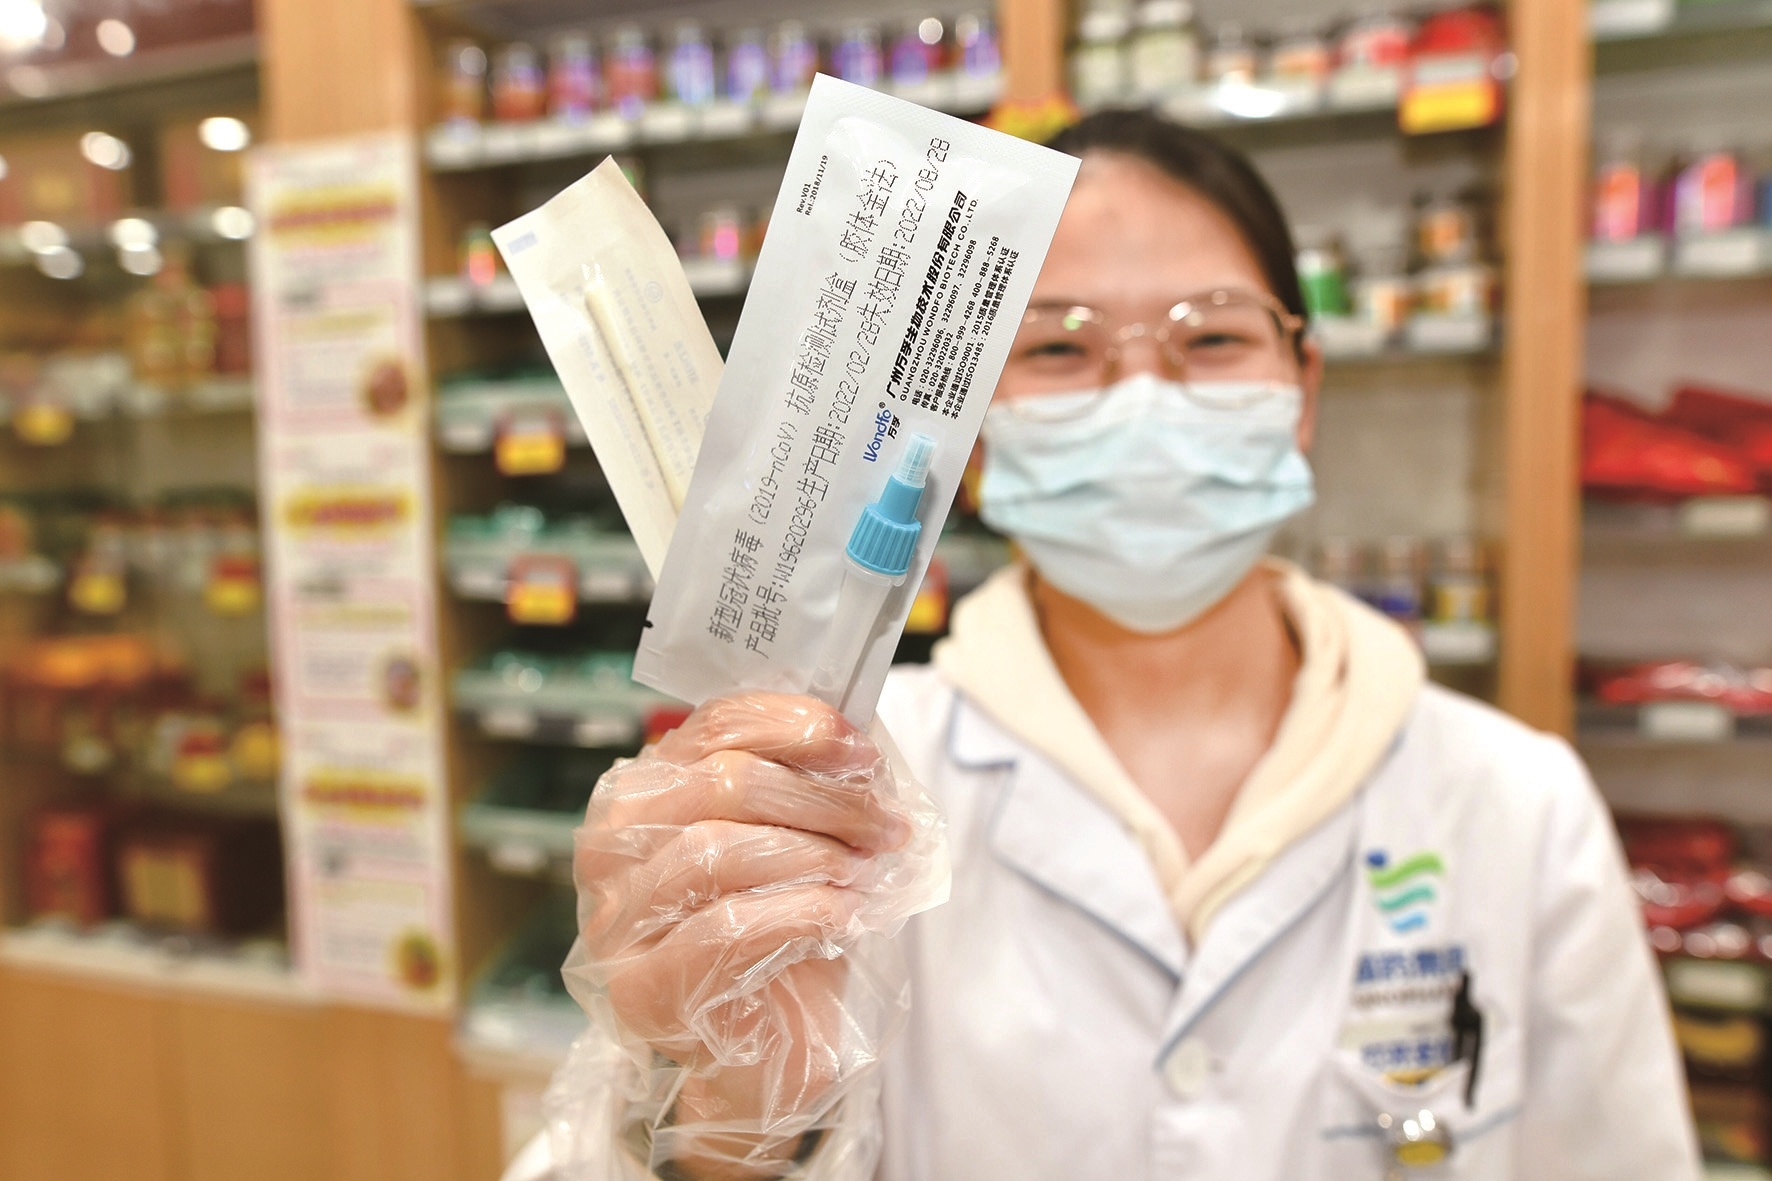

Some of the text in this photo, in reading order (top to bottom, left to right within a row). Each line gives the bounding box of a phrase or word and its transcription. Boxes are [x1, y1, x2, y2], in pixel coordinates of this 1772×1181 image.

[796, 184, 811, 213] Rev.V01
[886, 190, 967, 399] 广州万孚生物技术股份有限公司
[900, 199, 978, 401] GUANGZHOU WONDFO BIOTECH CO.,LTD.
[888, 415, 901, 439] 万孚
